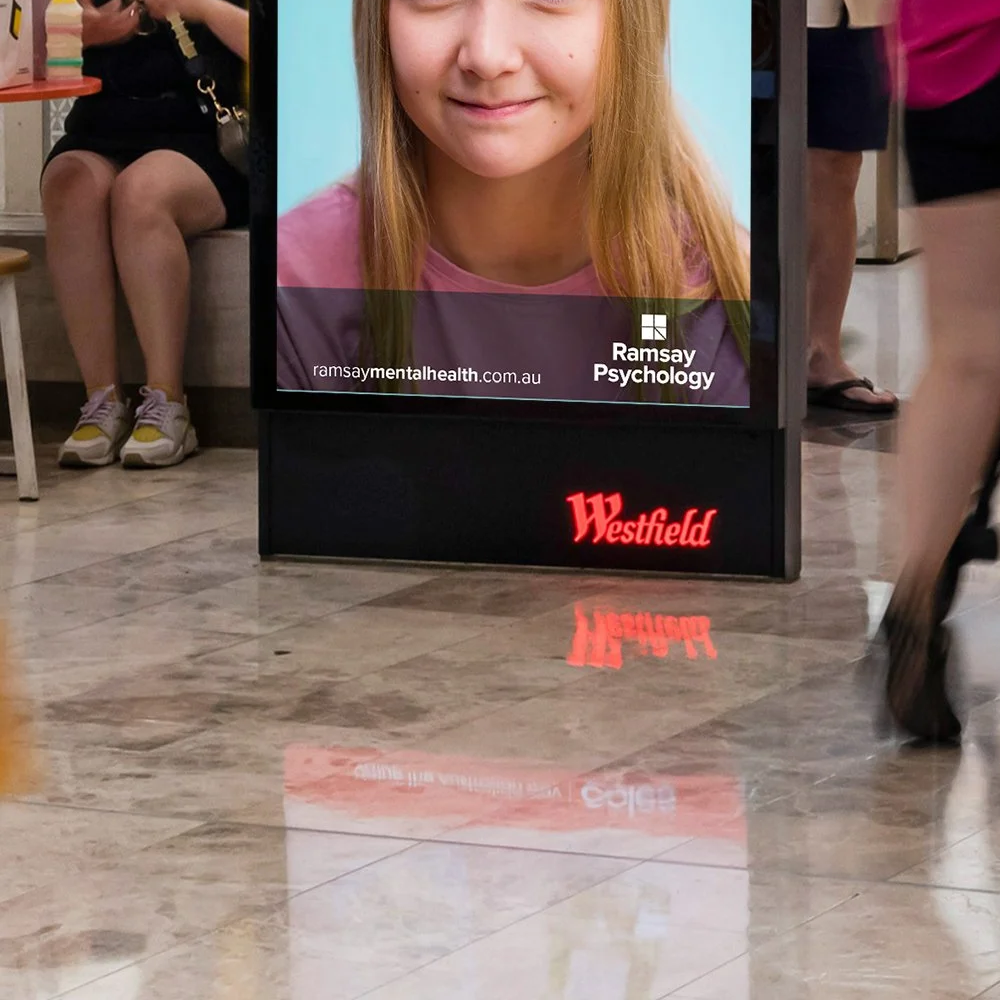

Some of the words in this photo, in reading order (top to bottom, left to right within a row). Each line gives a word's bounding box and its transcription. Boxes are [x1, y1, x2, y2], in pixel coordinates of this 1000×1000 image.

[612, 342, 696, 368] Ramsay
[313, 364, 541, 385] ramsaymentalhealth.com.au
[593, 363, 715, 390] Psychology
[566, 492, 718, 548] Westfield
